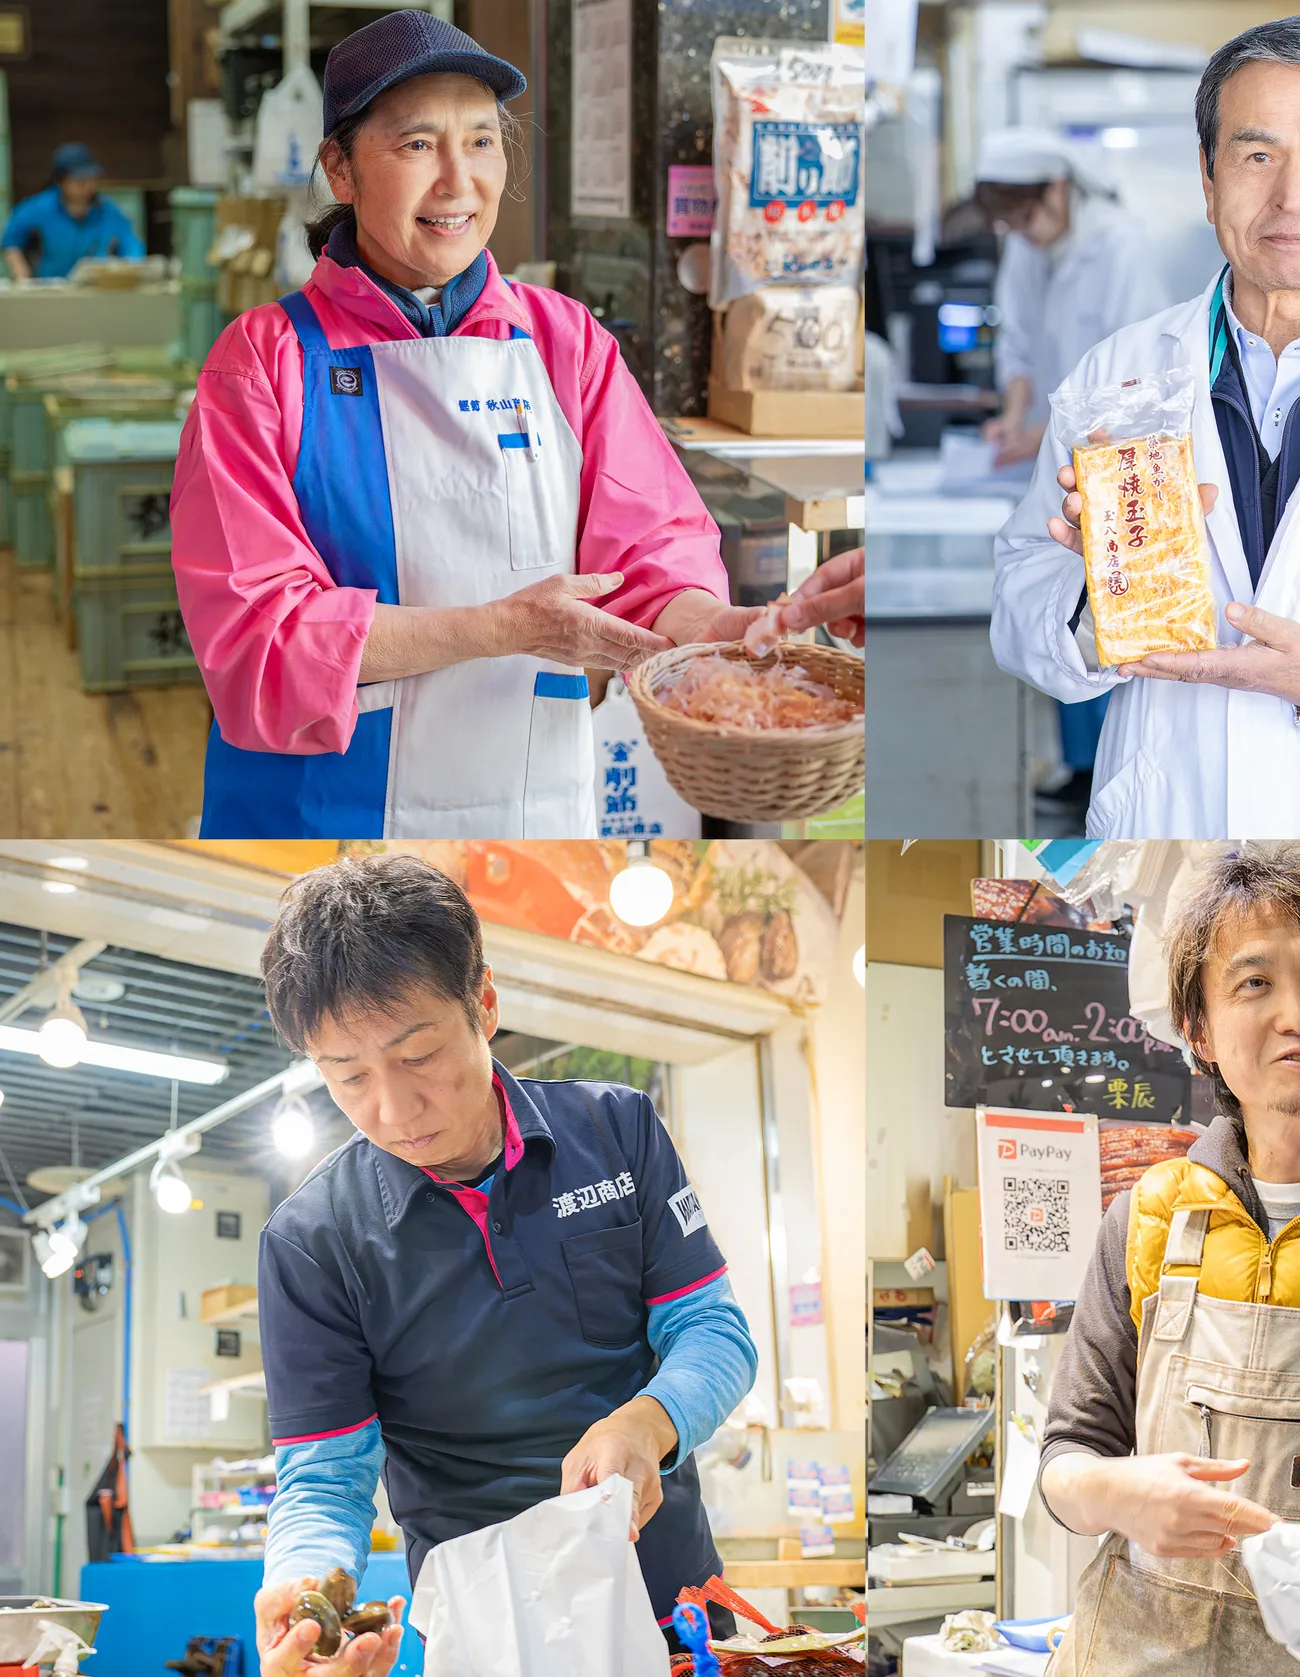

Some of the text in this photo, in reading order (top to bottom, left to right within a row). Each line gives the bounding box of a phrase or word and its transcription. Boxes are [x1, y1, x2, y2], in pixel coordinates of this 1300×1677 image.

[980, 1045, 1131, 1071] とさせて頂きます。
[1019, 1142, 1073, 1163] PayPay
[552, 1171, 636, 1219] 渡辺商店
